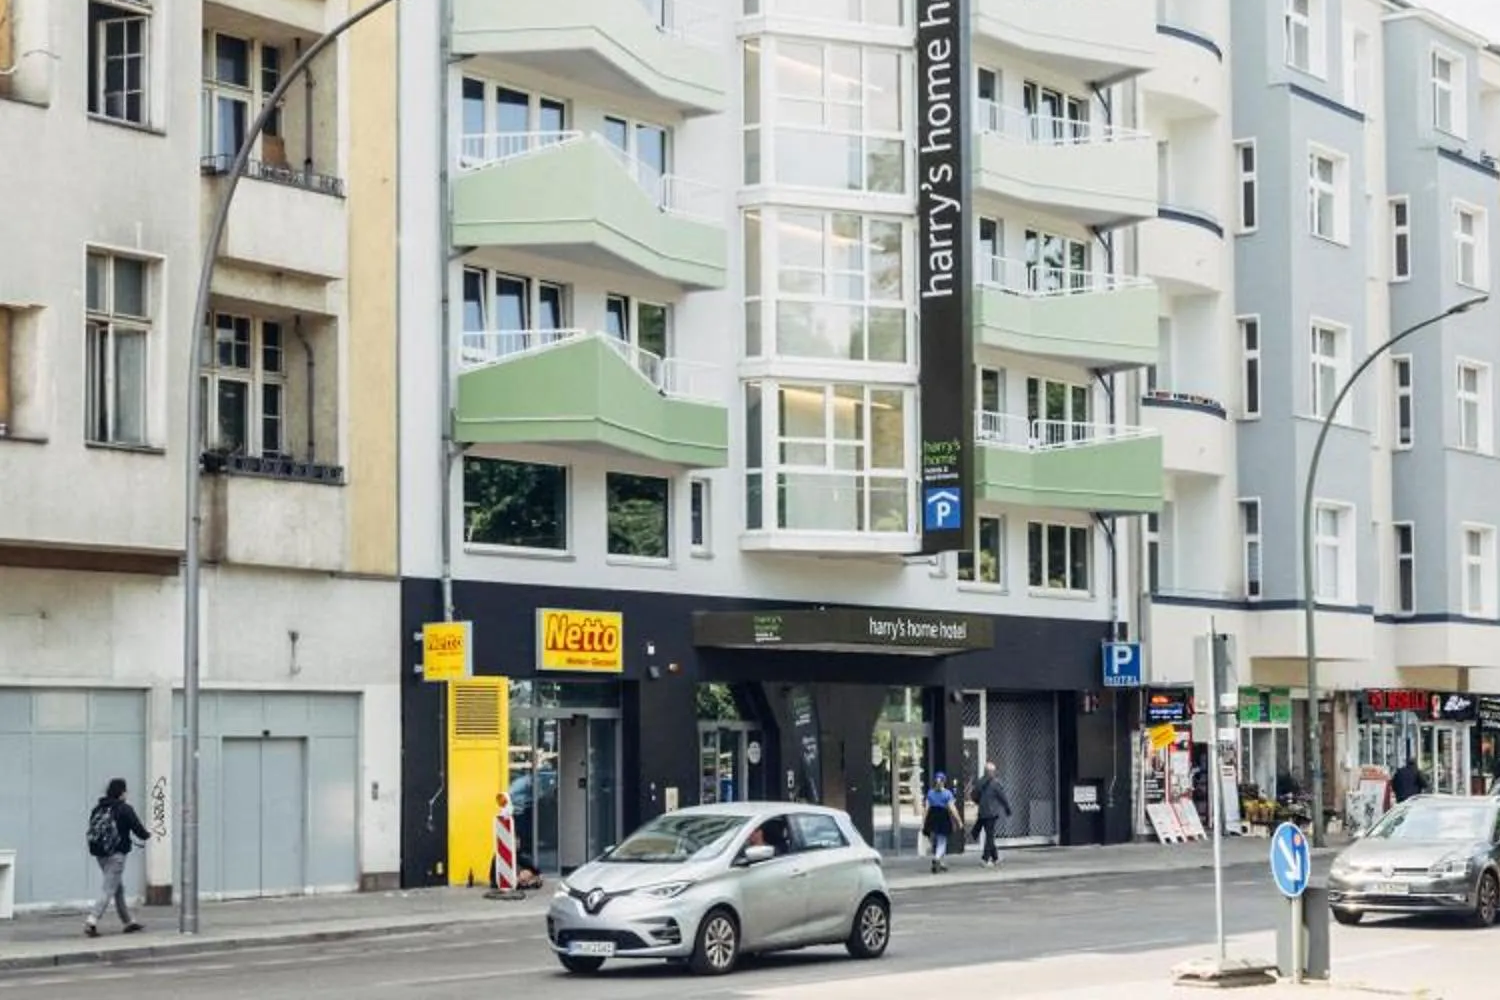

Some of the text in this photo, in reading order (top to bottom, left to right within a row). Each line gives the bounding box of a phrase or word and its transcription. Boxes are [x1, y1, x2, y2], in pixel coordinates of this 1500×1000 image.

[920, 37, 952, 153] home
[921, 162, 961, 299] harry's
[937, 501, 951, 528] P
[546, 613, 618, 653] Netto
[869, 616, 967, 640] harry's home hotel
[1113, 645, 1133, 675] P
